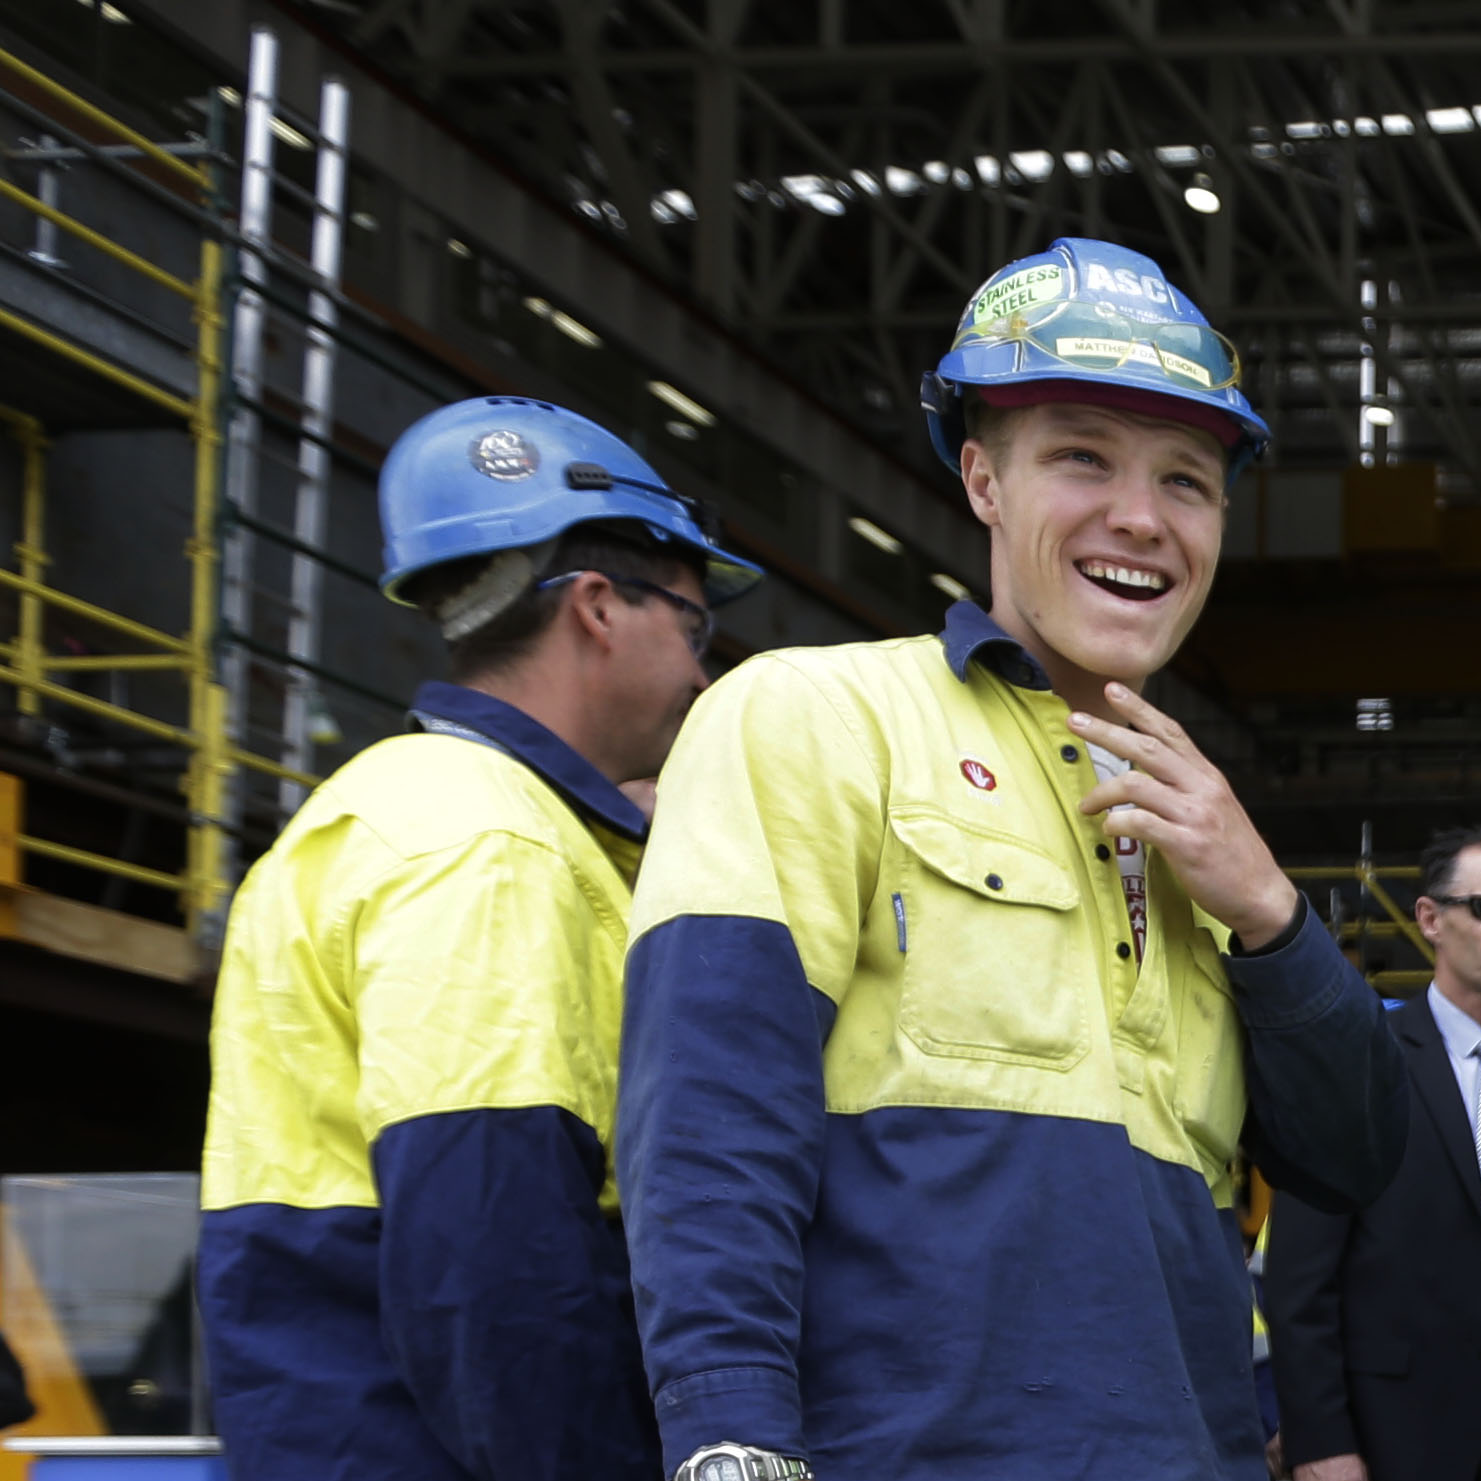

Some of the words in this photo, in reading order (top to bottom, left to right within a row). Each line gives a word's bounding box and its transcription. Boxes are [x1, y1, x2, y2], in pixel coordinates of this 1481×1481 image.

[977, 267, 1060, 313] STAINLESS
[1087, 263, 1168, 303] ASC
[992, 289, 1038, 318] STEEL
[1139, 349, 1199, 375] DAIDSON
